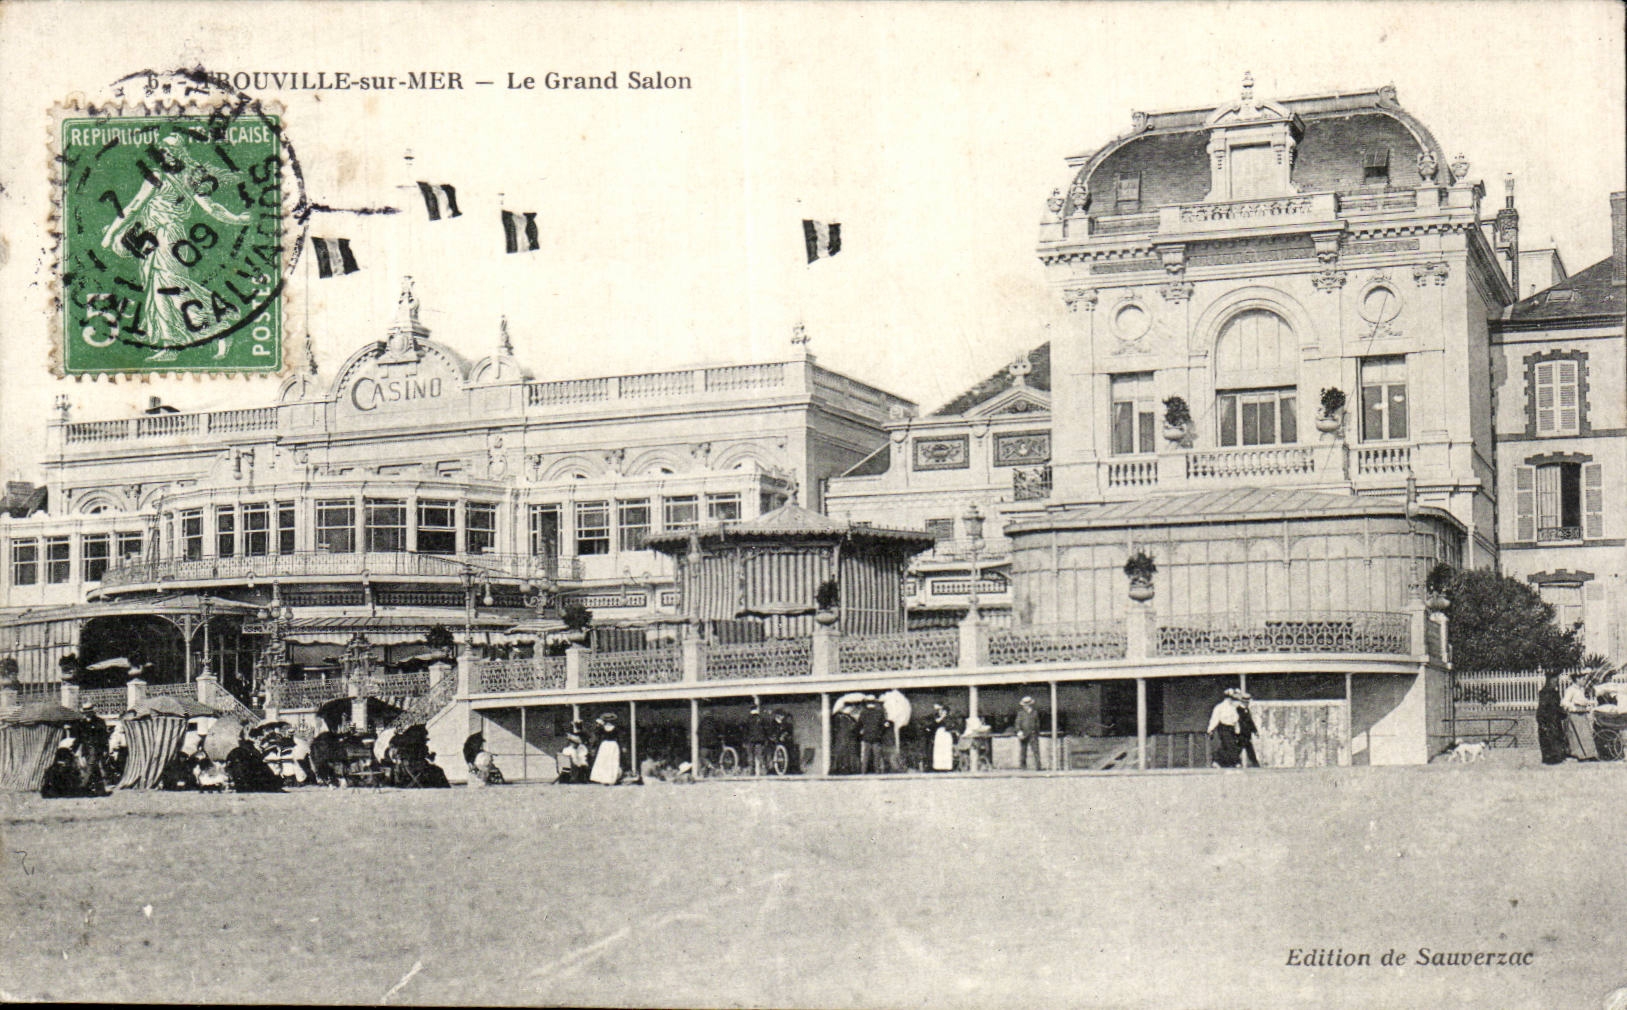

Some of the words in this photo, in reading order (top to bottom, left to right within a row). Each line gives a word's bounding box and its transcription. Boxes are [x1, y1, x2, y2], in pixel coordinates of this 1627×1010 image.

[171, 222, 219, 267] 09
[251, 274, 271, 356] POSTES
[350, 376, 442, 411] CASINO
